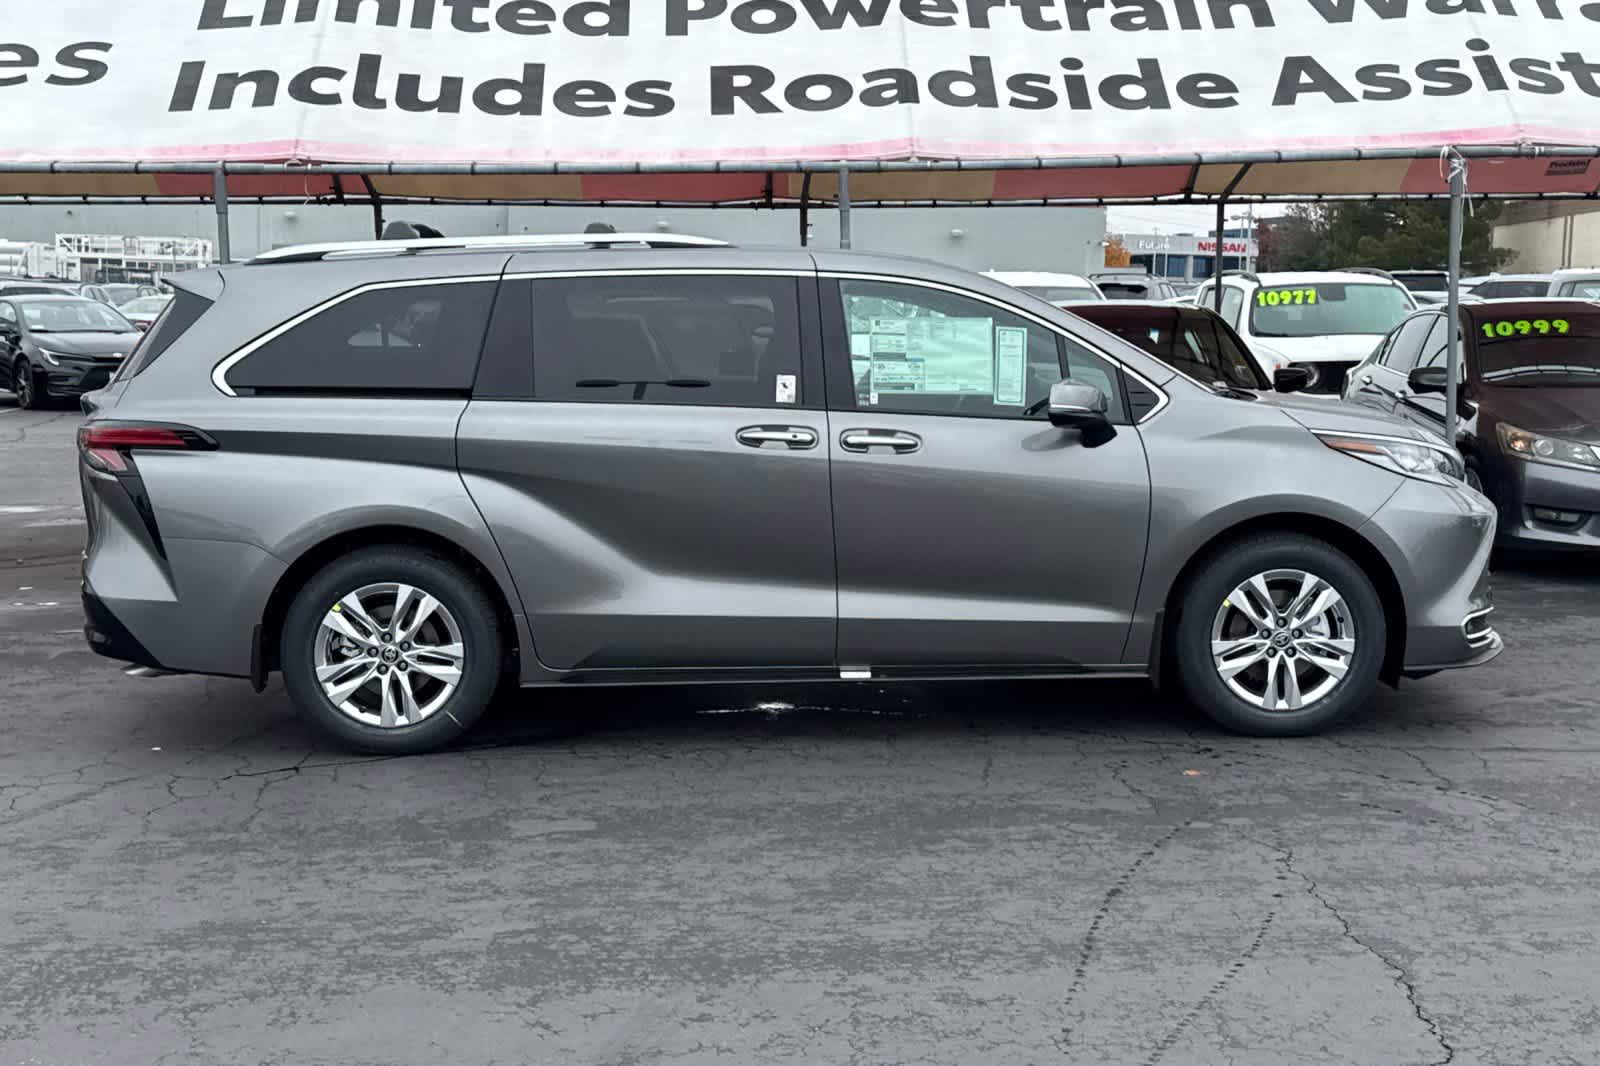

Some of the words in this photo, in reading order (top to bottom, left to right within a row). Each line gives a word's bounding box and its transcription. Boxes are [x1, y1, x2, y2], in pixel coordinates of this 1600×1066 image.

[665, 0, 1276, 37] Powertrain
[0, 41, 113, 87] es
[168, 54, 676, 118] Includes
[710, 55, 1239, 116] Roadside
[1271, 38, 1600, 106] Assist
[1197, 241, 1247, 253] NISSAN
[1256, 288, 1317, 307] 10977
[1481, 319, 1569, 338] 10999
